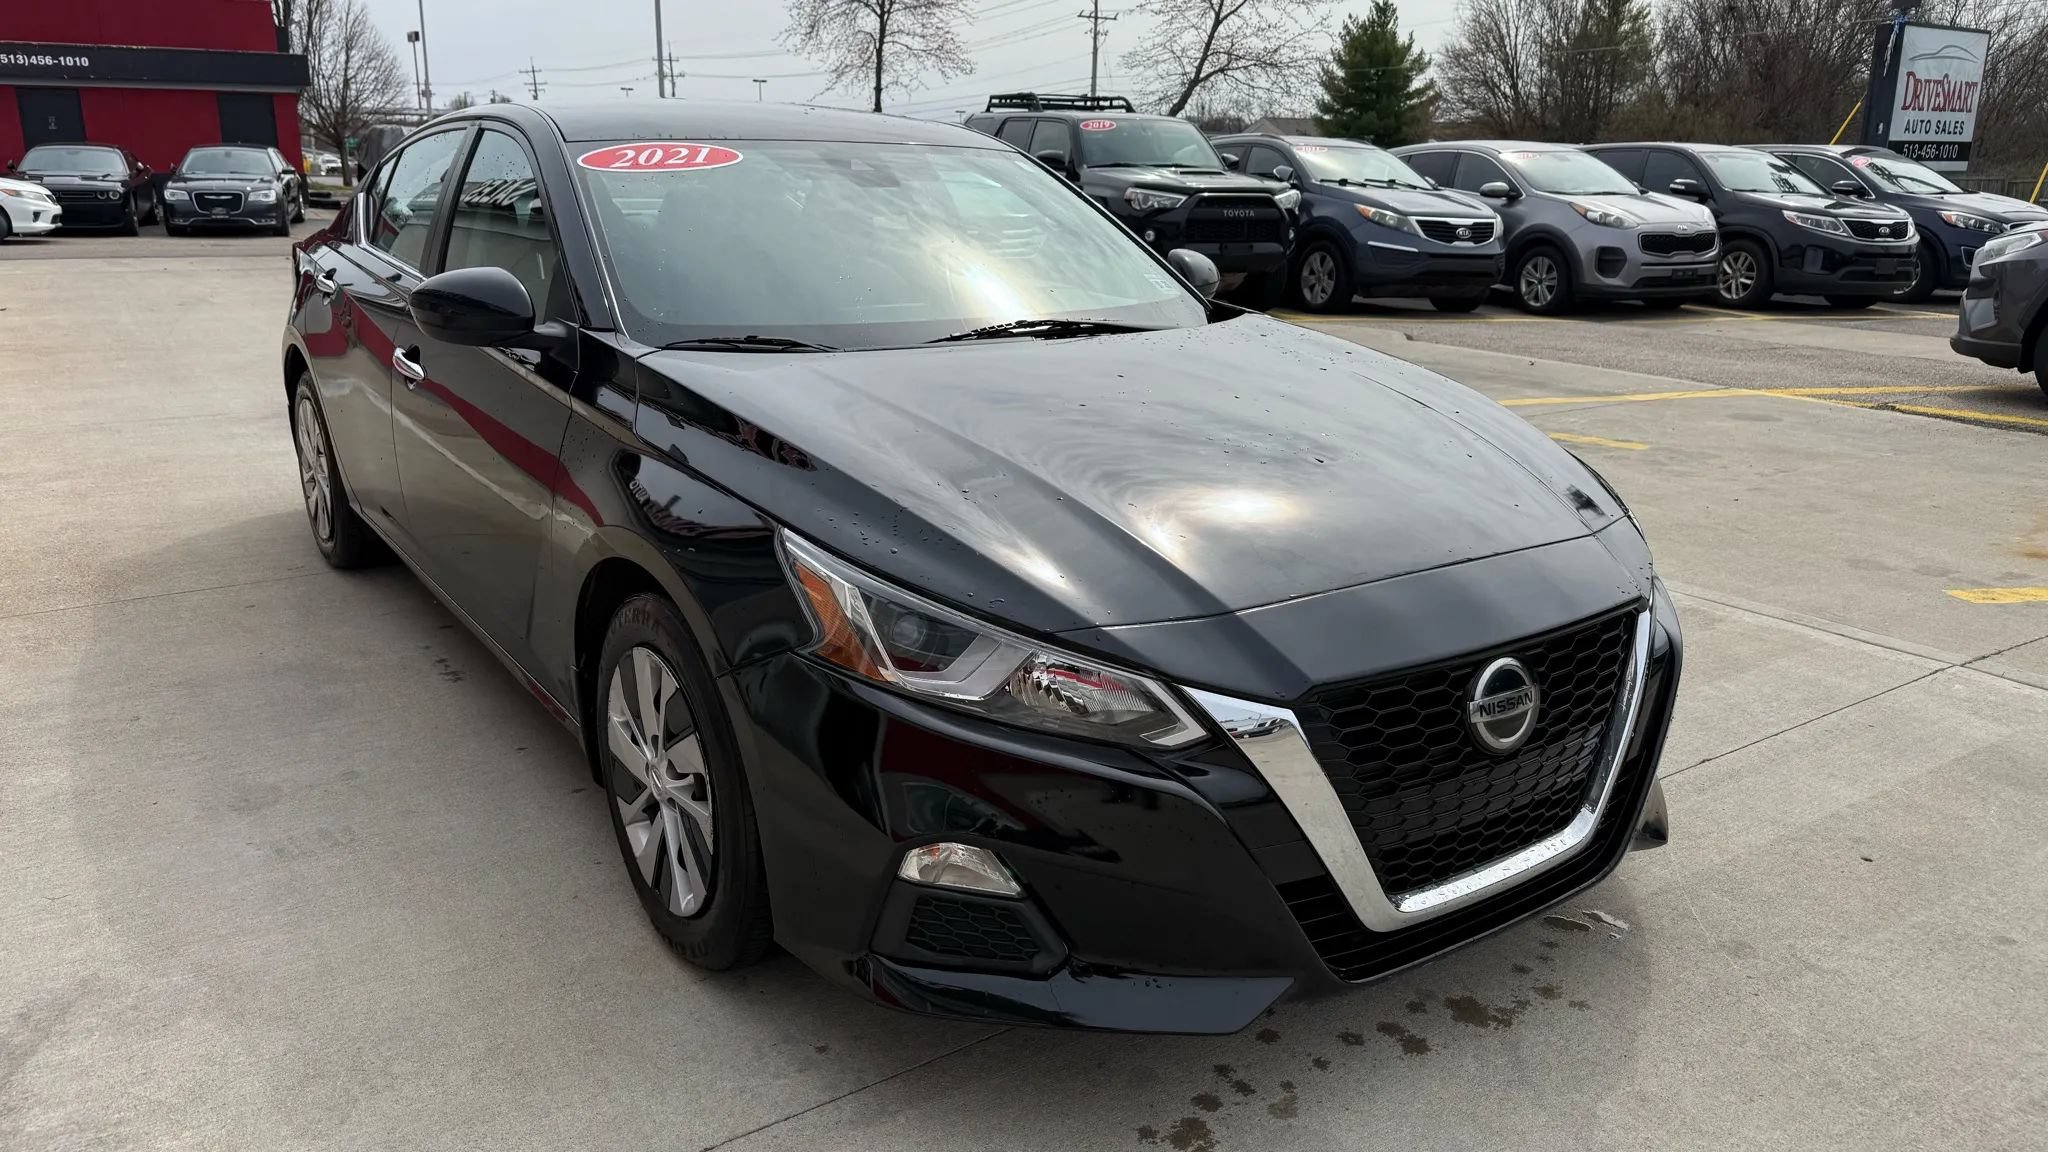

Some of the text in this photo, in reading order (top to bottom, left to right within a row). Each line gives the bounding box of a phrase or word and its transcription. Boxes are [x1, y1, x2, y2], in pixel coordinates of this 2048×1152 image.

[1904, 119, 1965, 136] AUTO SALES
[609, 147, 711, 168] 2021
[1902, 143, 1959, 160] 513-456-1010
[1223, 209, 1255, 217] TOYOTA
[1480, 690, 1533, 717] NISSAN
